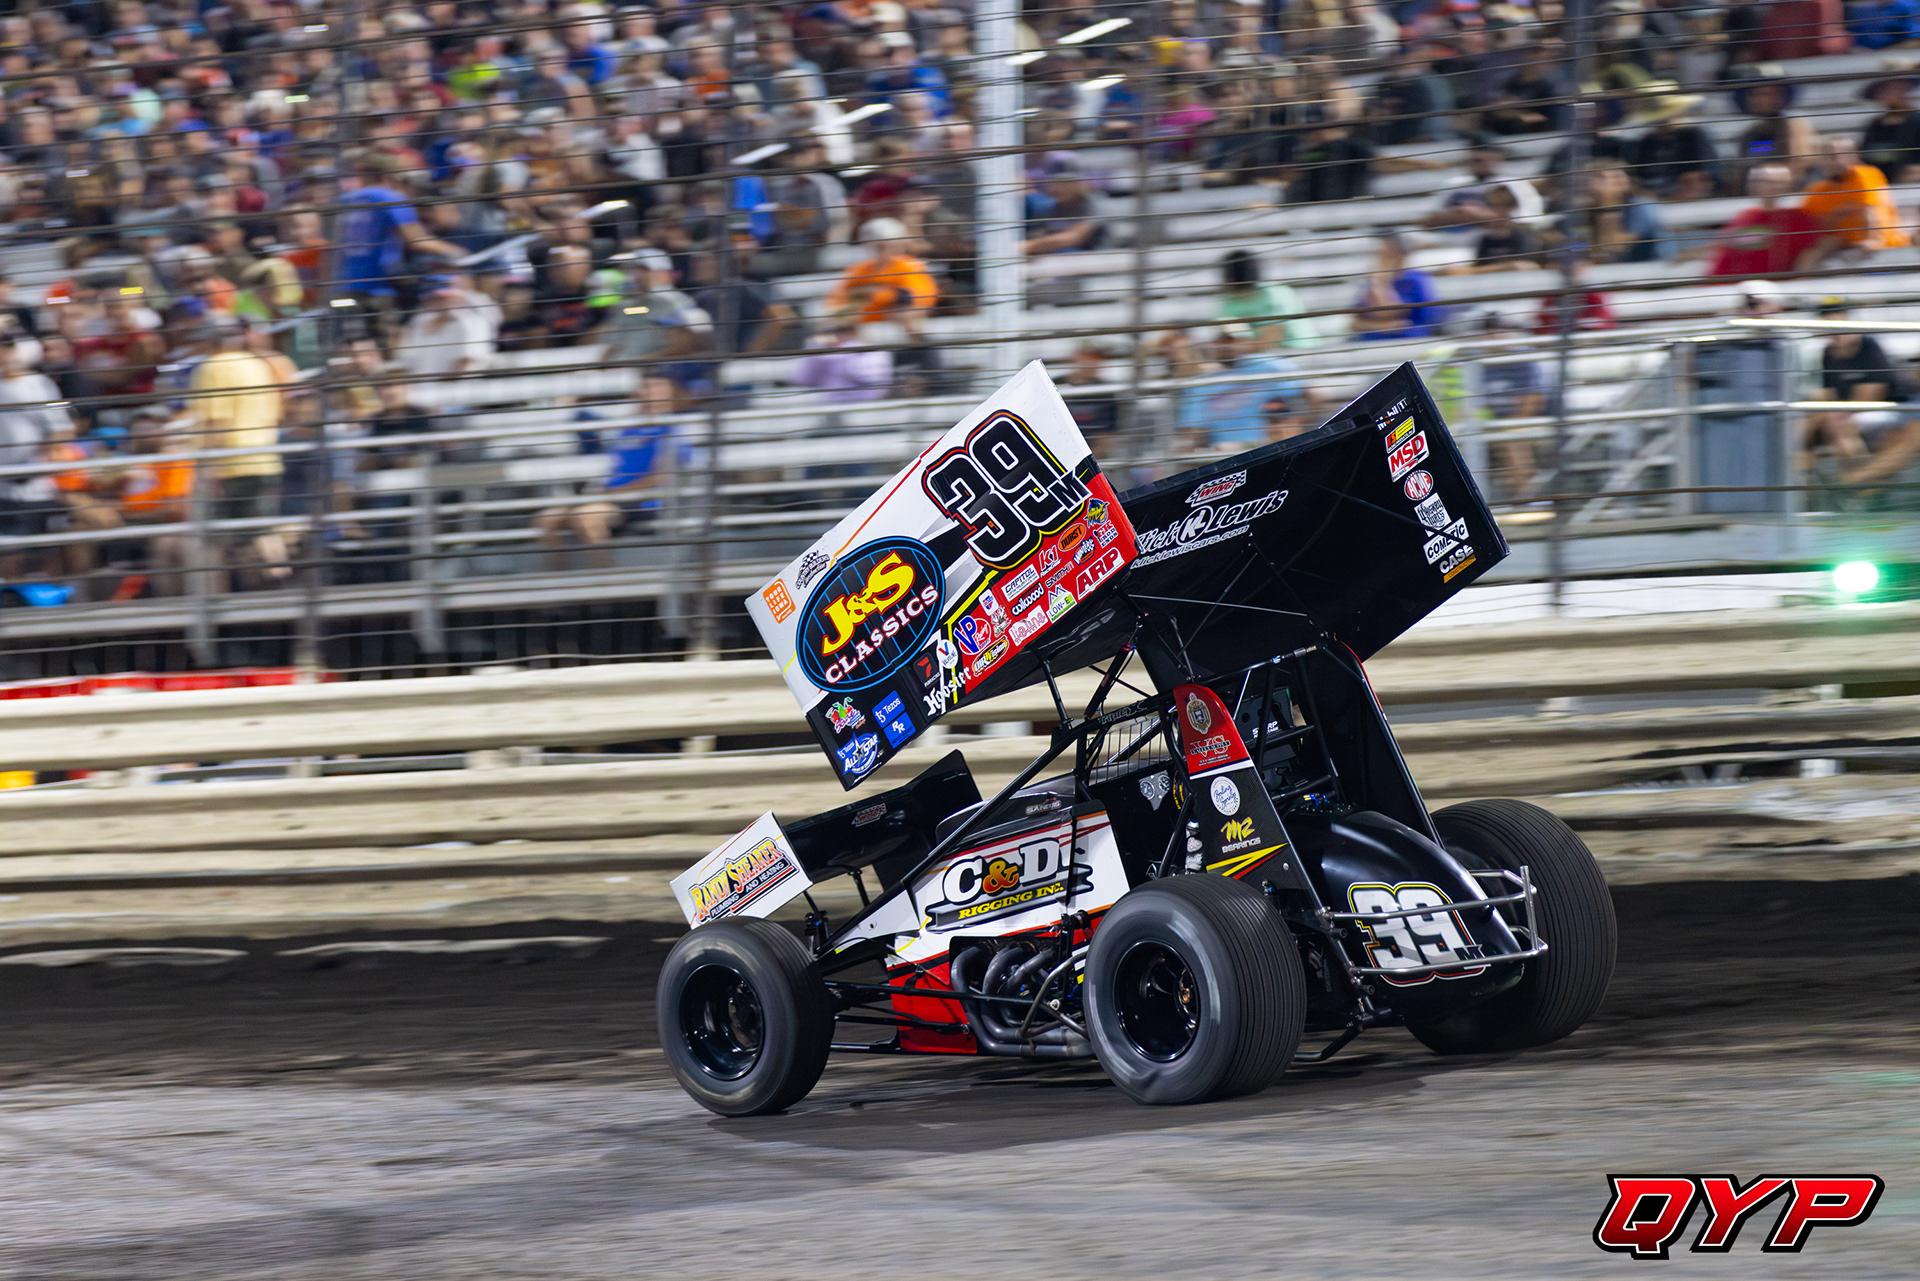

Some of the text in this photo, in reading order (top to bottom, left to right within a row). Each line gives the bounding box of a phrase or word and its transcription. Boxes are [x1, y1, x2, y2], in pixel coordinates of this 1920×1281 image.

[1390, 434, 1425, 473] MSD
[1199, 479, 1237, 499] WING
[1205, 489, 1290, 533] Lewis
[1060, 526, 1083, 549] DURST
[1130, 524, 1250, 569] klicklewiscars.com
[1039, 544, 1059, 570] K1
[1077, 547, 1118, 597] ARP
[1440, 544, 1474, 573] CASE
[765, 586, 782, 602] YOUR
[1004, 567, 1035, 593] CAPITOL
[768, 593, 786, 608] LIFE
[772, 600, 788, 615] IOWA
[821, 549, 916, 656] J&S
[1011, 582, 1045, 616] wilwood
[825, 584, 939, 684] CLASSICS
[953, 615, 980, 654] VP
[882, 697, 901, 714] Tezos
[922, 666, 971, 717] Hoosier
[862, 734, 879, 757] STAR
[1222, 837, 1261, 853] BEARINGS
[690, 839, 784, 921] RANDY SHEARER
[710, 862, 785, 918] PLUMBING AND HEATING
[957, 882, 1065, 920] RIGGING INC.
